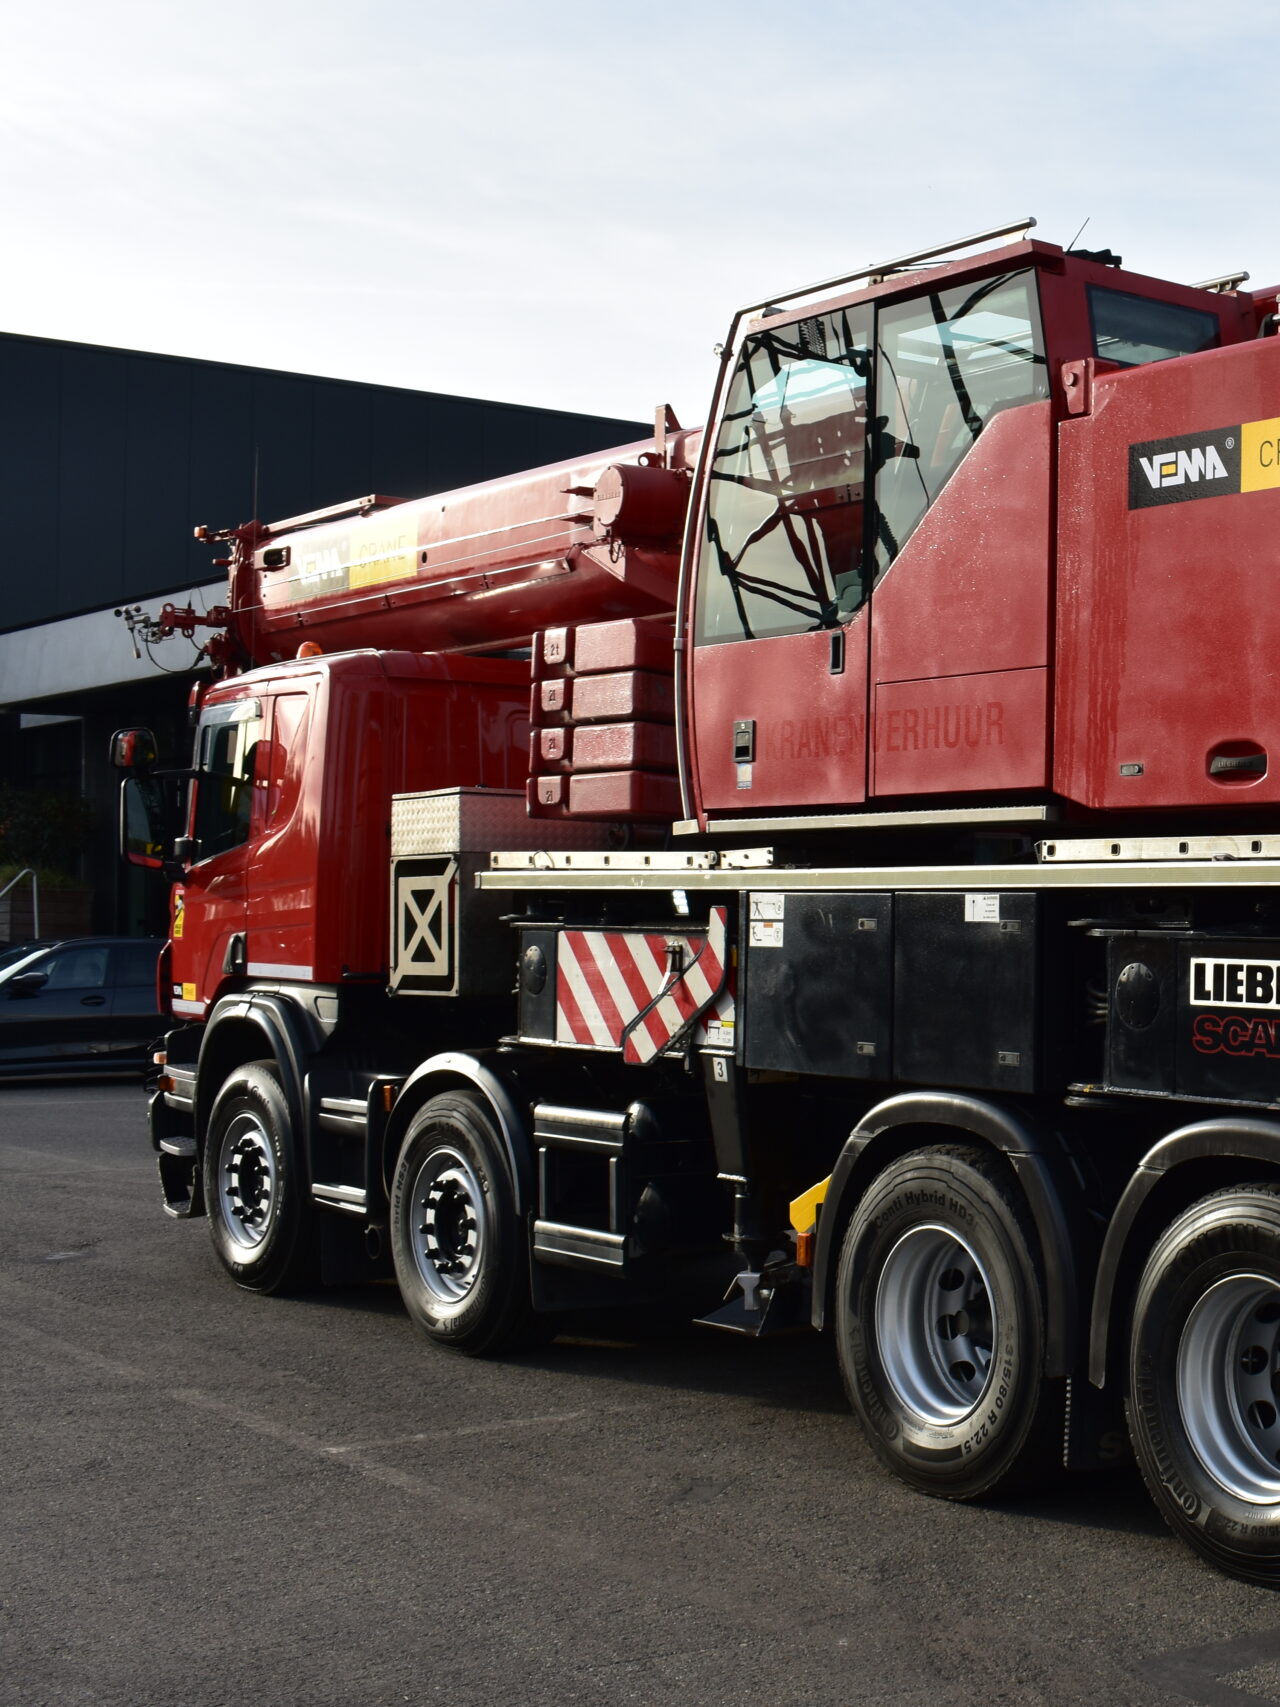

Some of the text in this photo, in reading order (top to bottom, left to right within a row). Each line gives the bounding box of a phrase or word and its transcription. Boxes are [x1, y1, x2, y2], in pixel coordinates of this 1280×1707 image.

[1138, 444, 1230, 489] VEMA
[717, 1060, 724, 1078] 3
[873, 1196, 903, 1231] Conti
[904, 1189, 947, 1209] Hybrid
[963, 1343, 1014, 1455] 315/80 R 22.5
